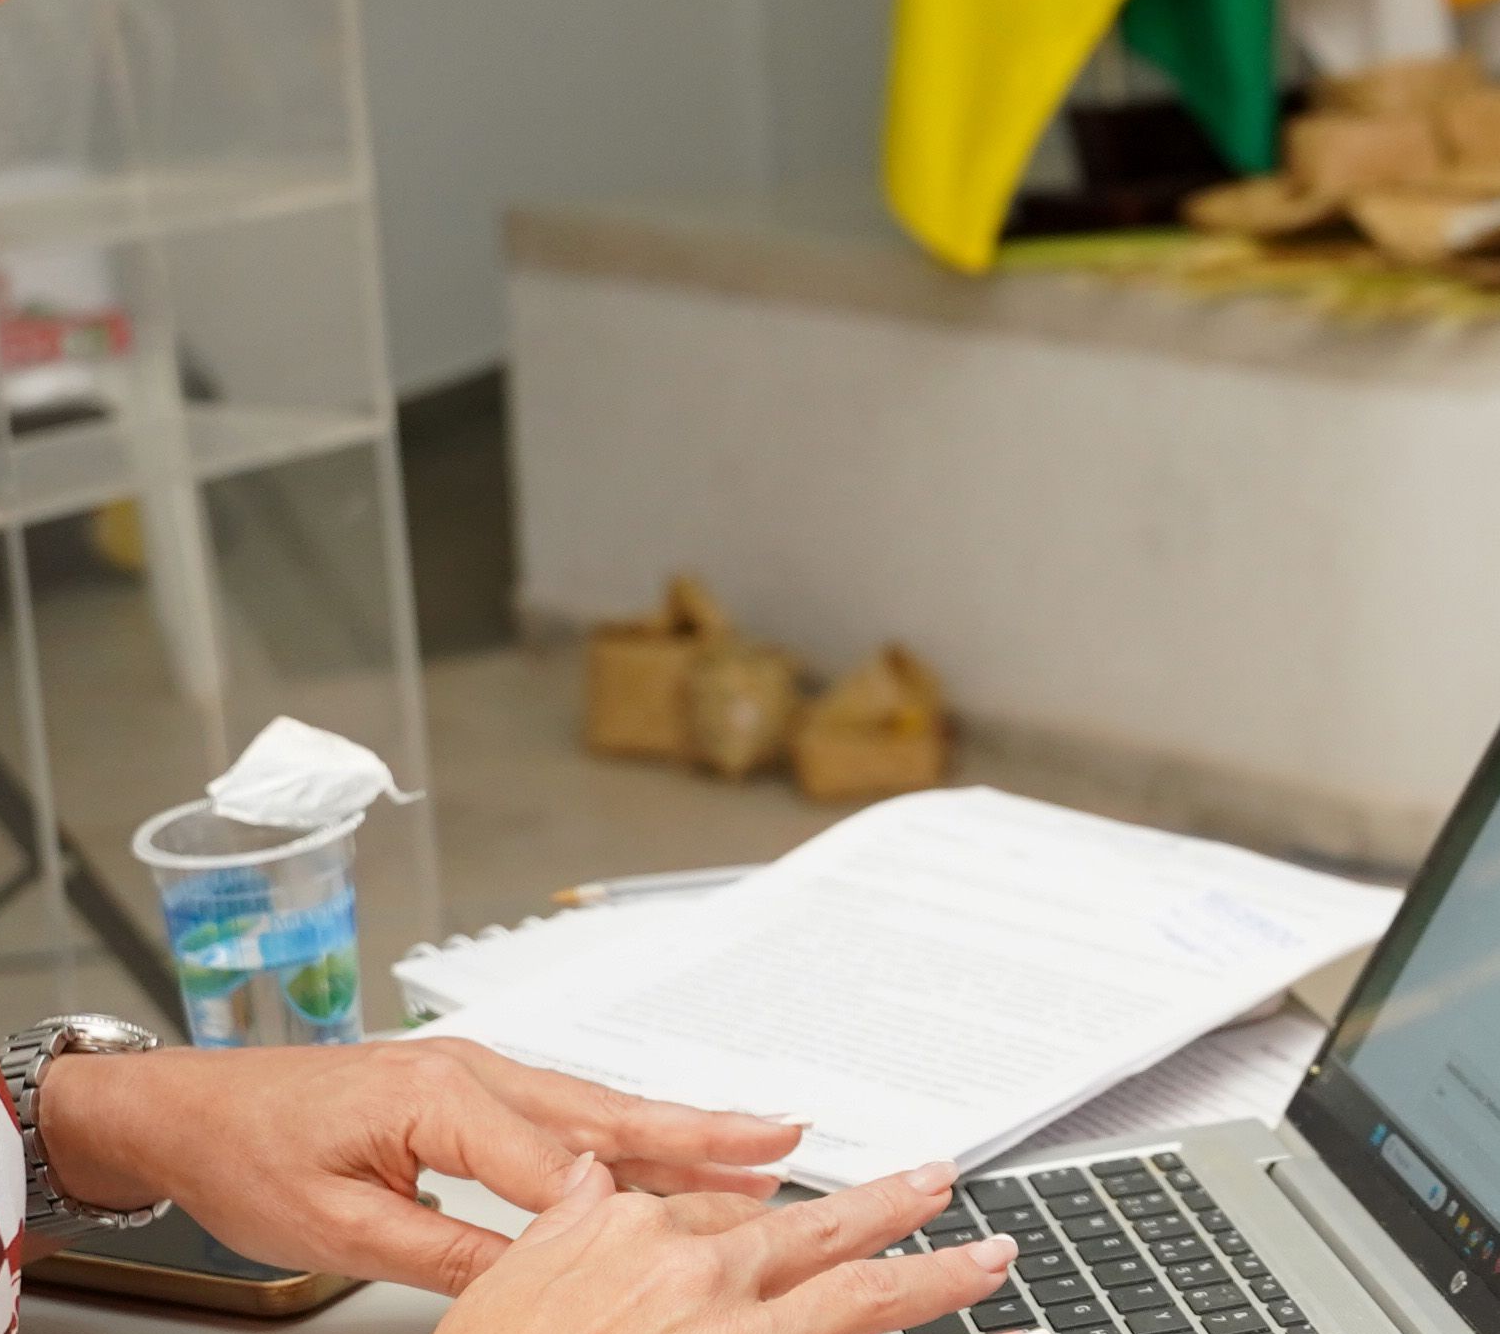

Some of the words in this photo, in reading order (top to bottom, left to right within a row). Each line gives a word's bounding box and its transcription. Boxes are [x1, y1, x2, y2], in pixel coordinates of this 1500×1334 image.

[1041, 1254, 1060, 1265] D
[1056, 1278, 1075, 1288] F
[1137, 1286, 1155, 1296] T
[999, 1303, 1016, 1313] V
[1074, 1304, 1092, 1315] G
[1155, 1311, 1172, 1320] Y
